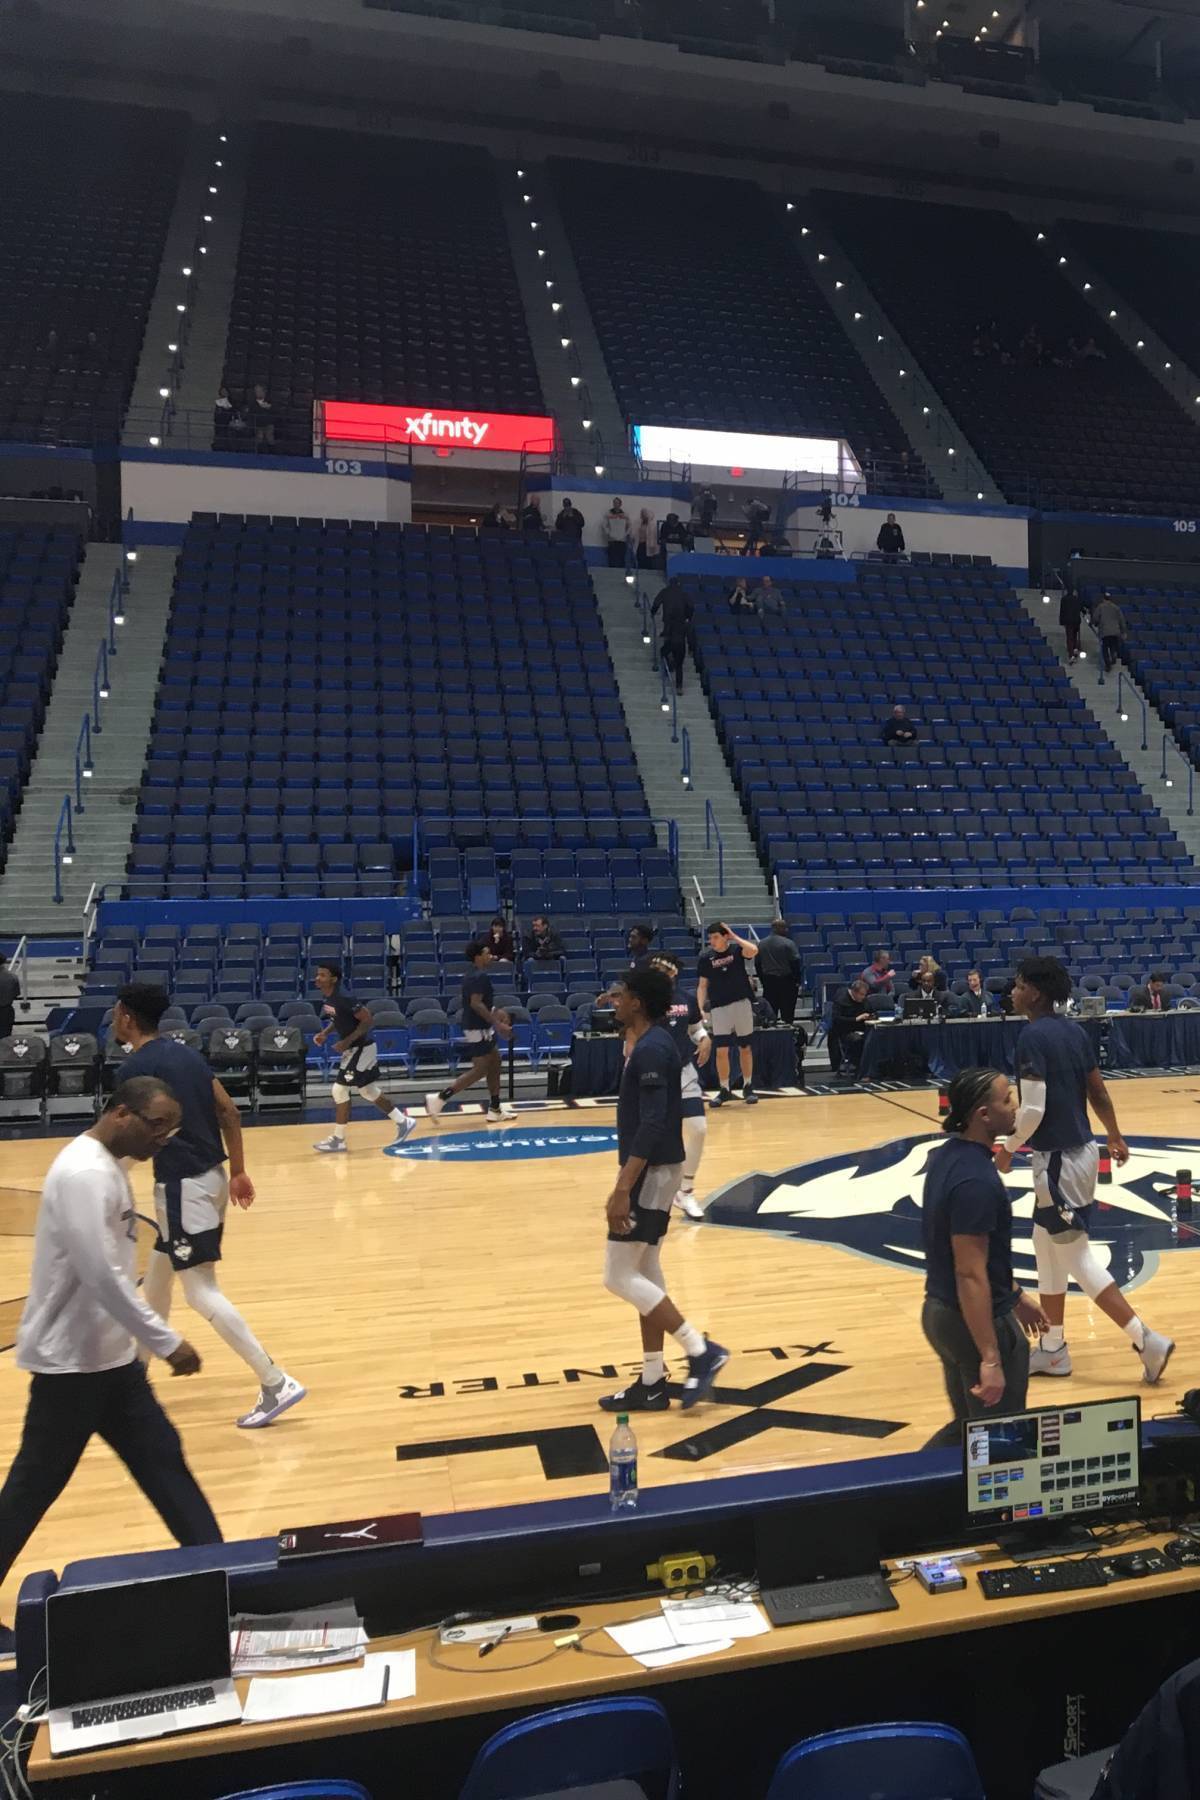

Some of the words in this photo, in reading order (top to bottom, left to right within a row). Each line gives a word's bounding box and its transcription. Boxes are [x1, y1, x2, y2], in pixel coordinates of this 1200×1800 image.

[405, 412, 489, 445] xfinity
[325, 459, 362, 474] 103
[829, 493, 860, 506] 104
[1173, 519, 1197, 532] 105
[743, 1341, 844, 1360] XL
